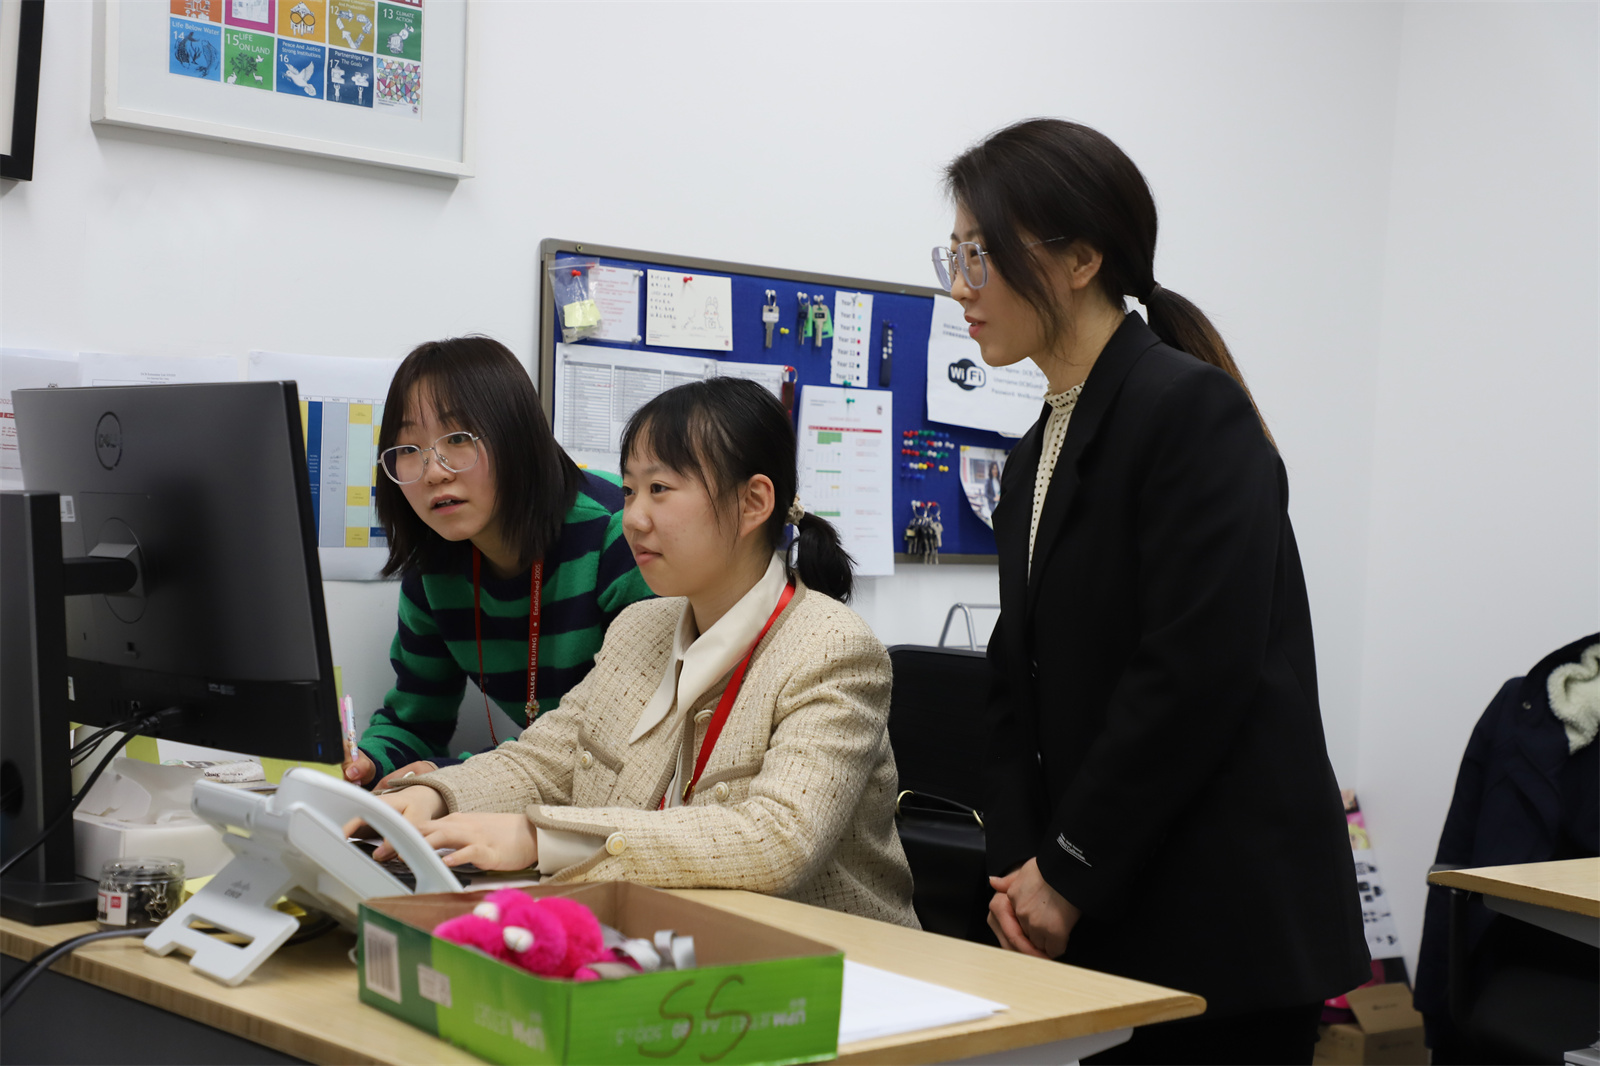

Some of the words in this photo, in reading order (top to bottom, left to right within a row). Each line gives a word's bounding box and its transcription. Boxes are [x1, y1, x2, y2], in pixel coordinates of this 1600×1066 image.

[330, 5, 340, 15] 12
[383, 8, 394, 19] 13
[396, 10, 415, 19] CLIMATE
[172, 20, 184, 29] Life
[185, 22, 203, 32] Below
[203, 27, 220, 36] Water
[173, 30, 185, 40] 14
[226, 33, 239, 46] 15
[238, 33, 253, 42] LIFE
[238, 43, 250, 51] ON
[251, 45, 270, 55] LAND
[282, 41, 296, 49] Peace
[305, 45, 321, 53] Justice
[279, 54, 290, 63] 16
[281, 47, 297, 55] Strong
[297, 49, 321, 59] Institutions
[334, 50, 361, 61] Partnerships
[329, 59, 340, 68] 17
[350, 60, 363, 68] Goals
[841, 311, 851, 319] Year
[534, 563, 542, 579] 2005
[533, 580, 541, 616] Established
[530, 637, 538, 667] BEIJING
[529, 671, 537, 700] OLLEGE
